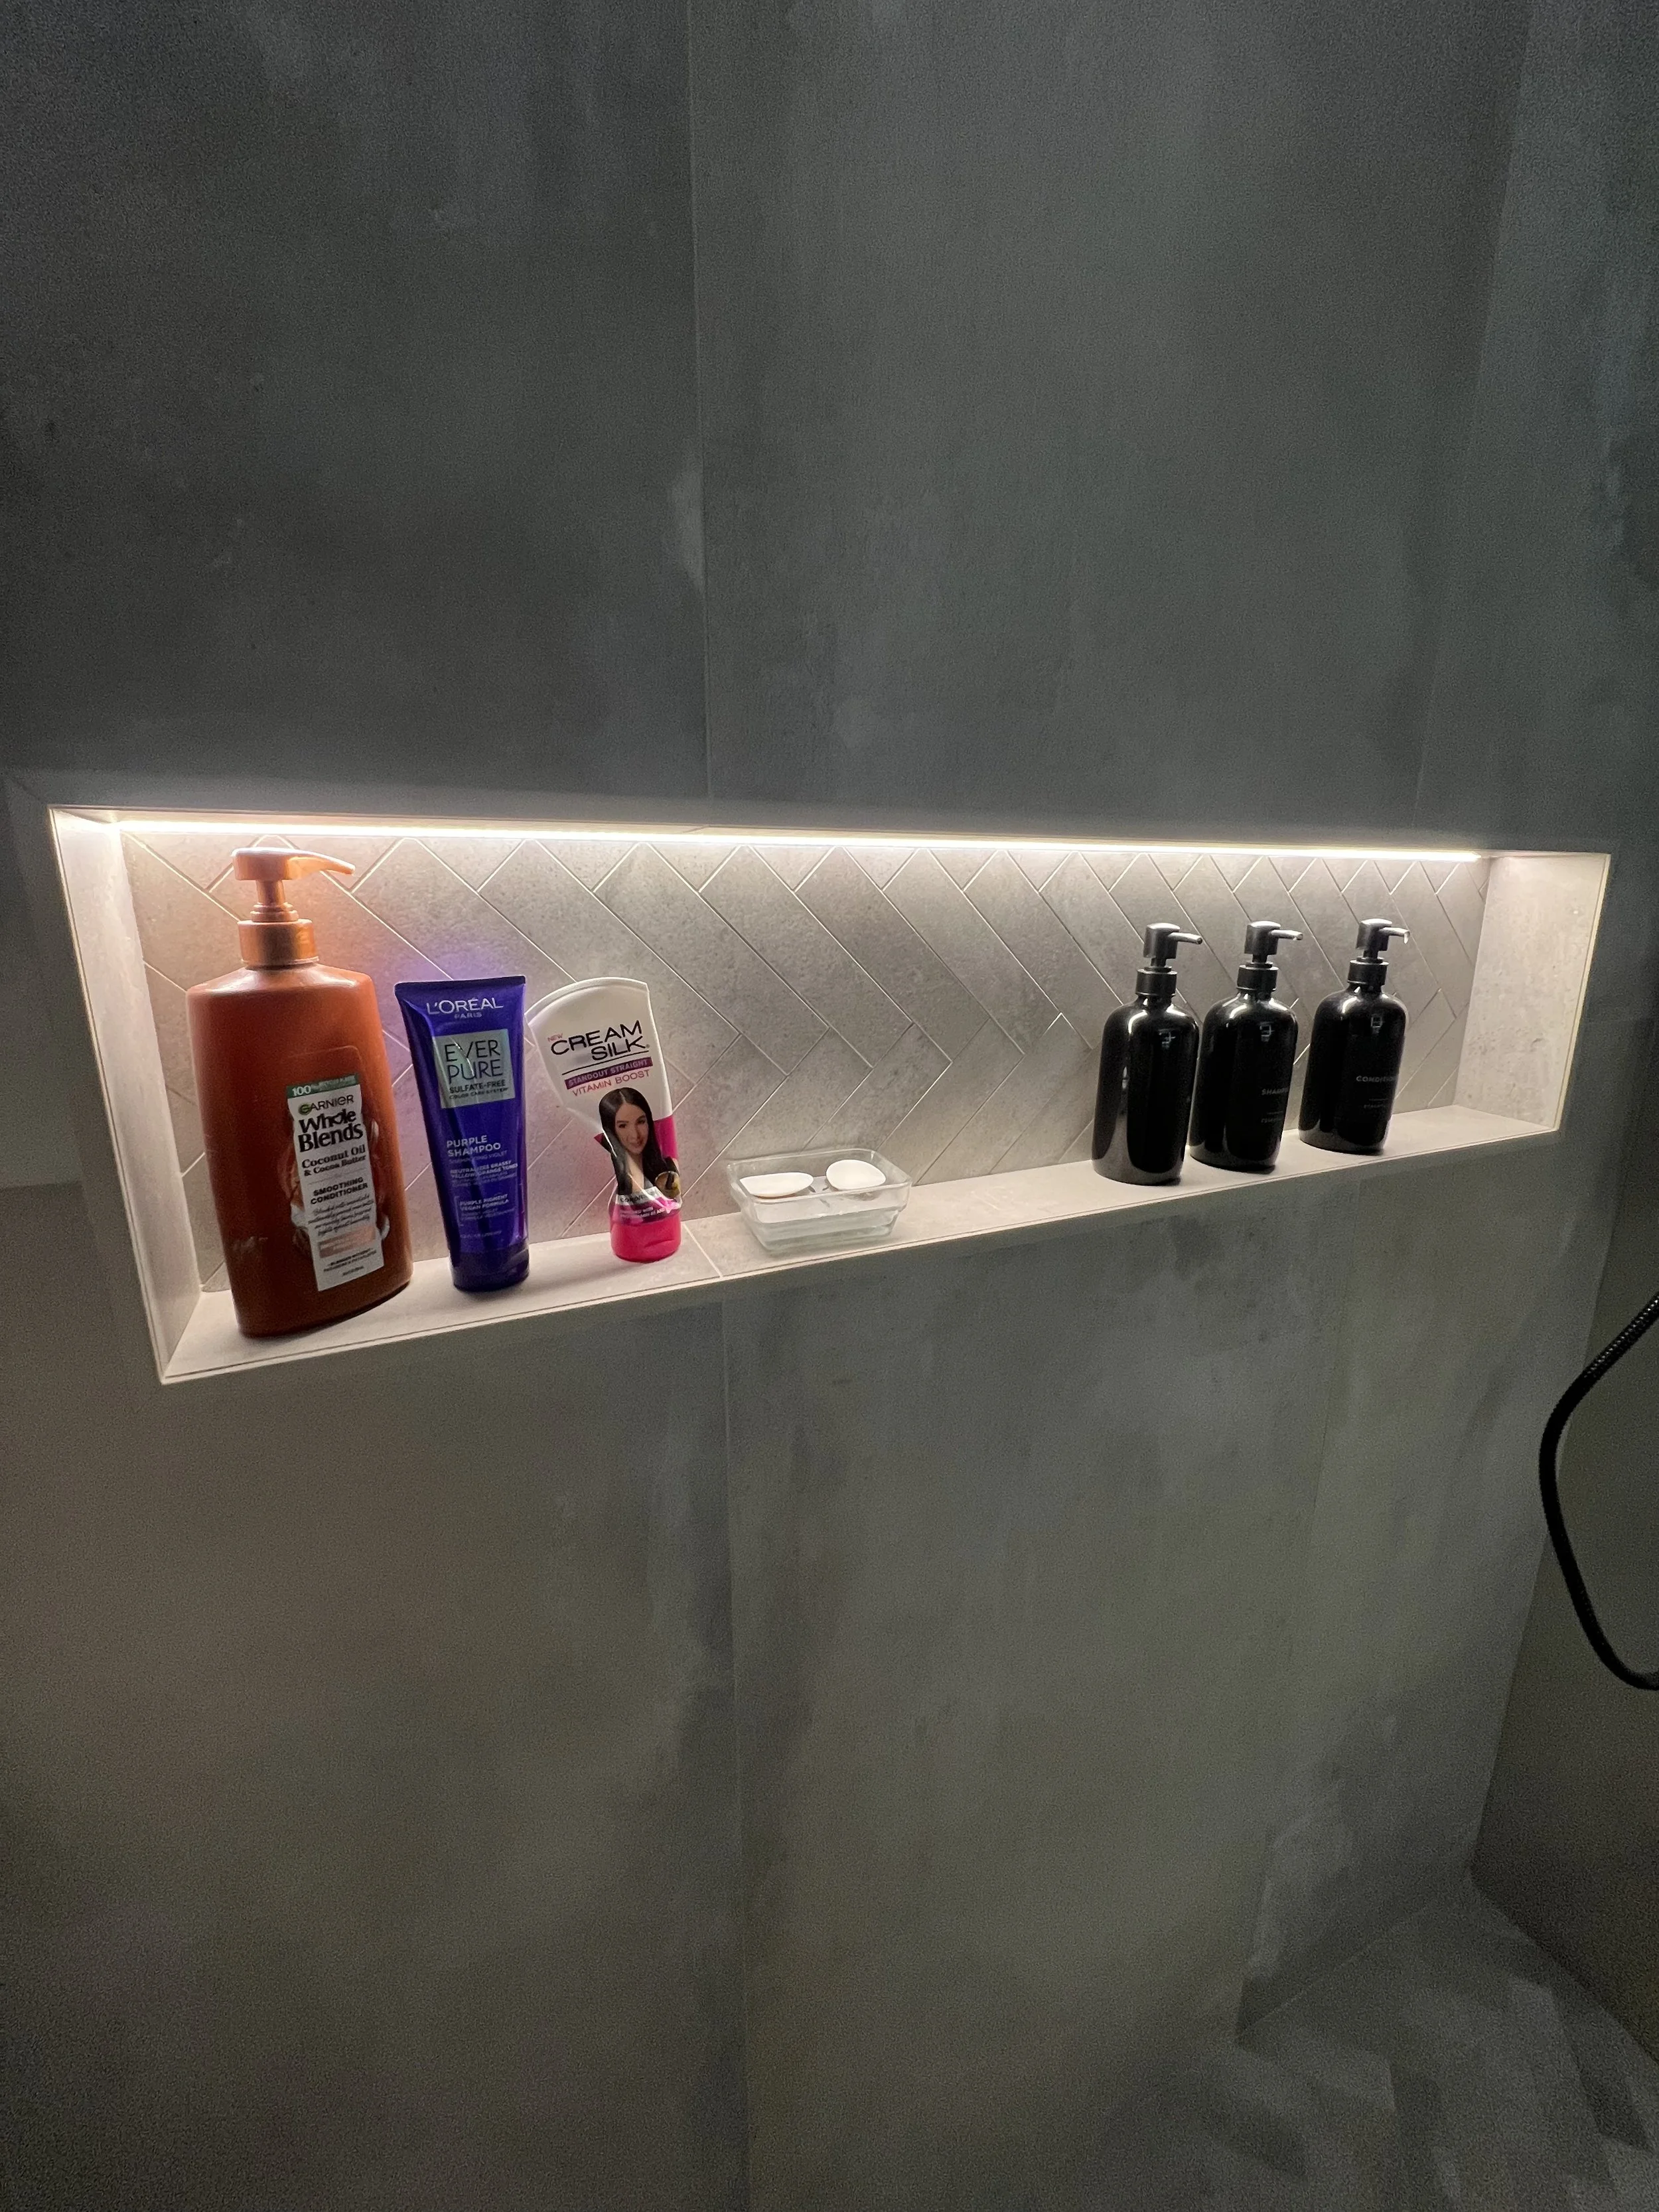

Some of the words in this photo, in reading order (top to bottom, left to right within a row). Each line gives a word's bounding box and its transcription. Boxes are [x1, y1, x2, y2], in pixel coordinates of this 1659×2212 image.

[426, 997, 504, 1015] L'ORÉAL
[547, 1033, 563, 1043] NEW
[551, 1019, 642, 1055] CREAM
[591, 1035, 646, 1061] SILK
[445, 1039, 501, 1063] EVER
[447, 1059, 504, 1085] PURE
[568, 1069, 609, 1086] STANDOUT
[611, 1059, 648, 1074] STRAIGHT
[572, 1080, 613, 1097] VITAMIN
[614, 1069, 651, 1085] BOOST
[449, 1079, 506, 1094] SULFATE-FREE
[299, 1094, 354, 1116] GARNIER
[299, 1108, 356, 1134] Whole
[298, 1123, 364, 1153] Blends
[447, 1135, 488, 1149] PURPLE
[447, 1142, 501, 1157] SHAMPOO
[301, 1150, 349, 1169] Coconut
[350, 1144, 366, 1155] Oil
[311, 1183, 368, 1205] CONDITIONER
[313, 1177, 364, 1196] SMOOTHING
